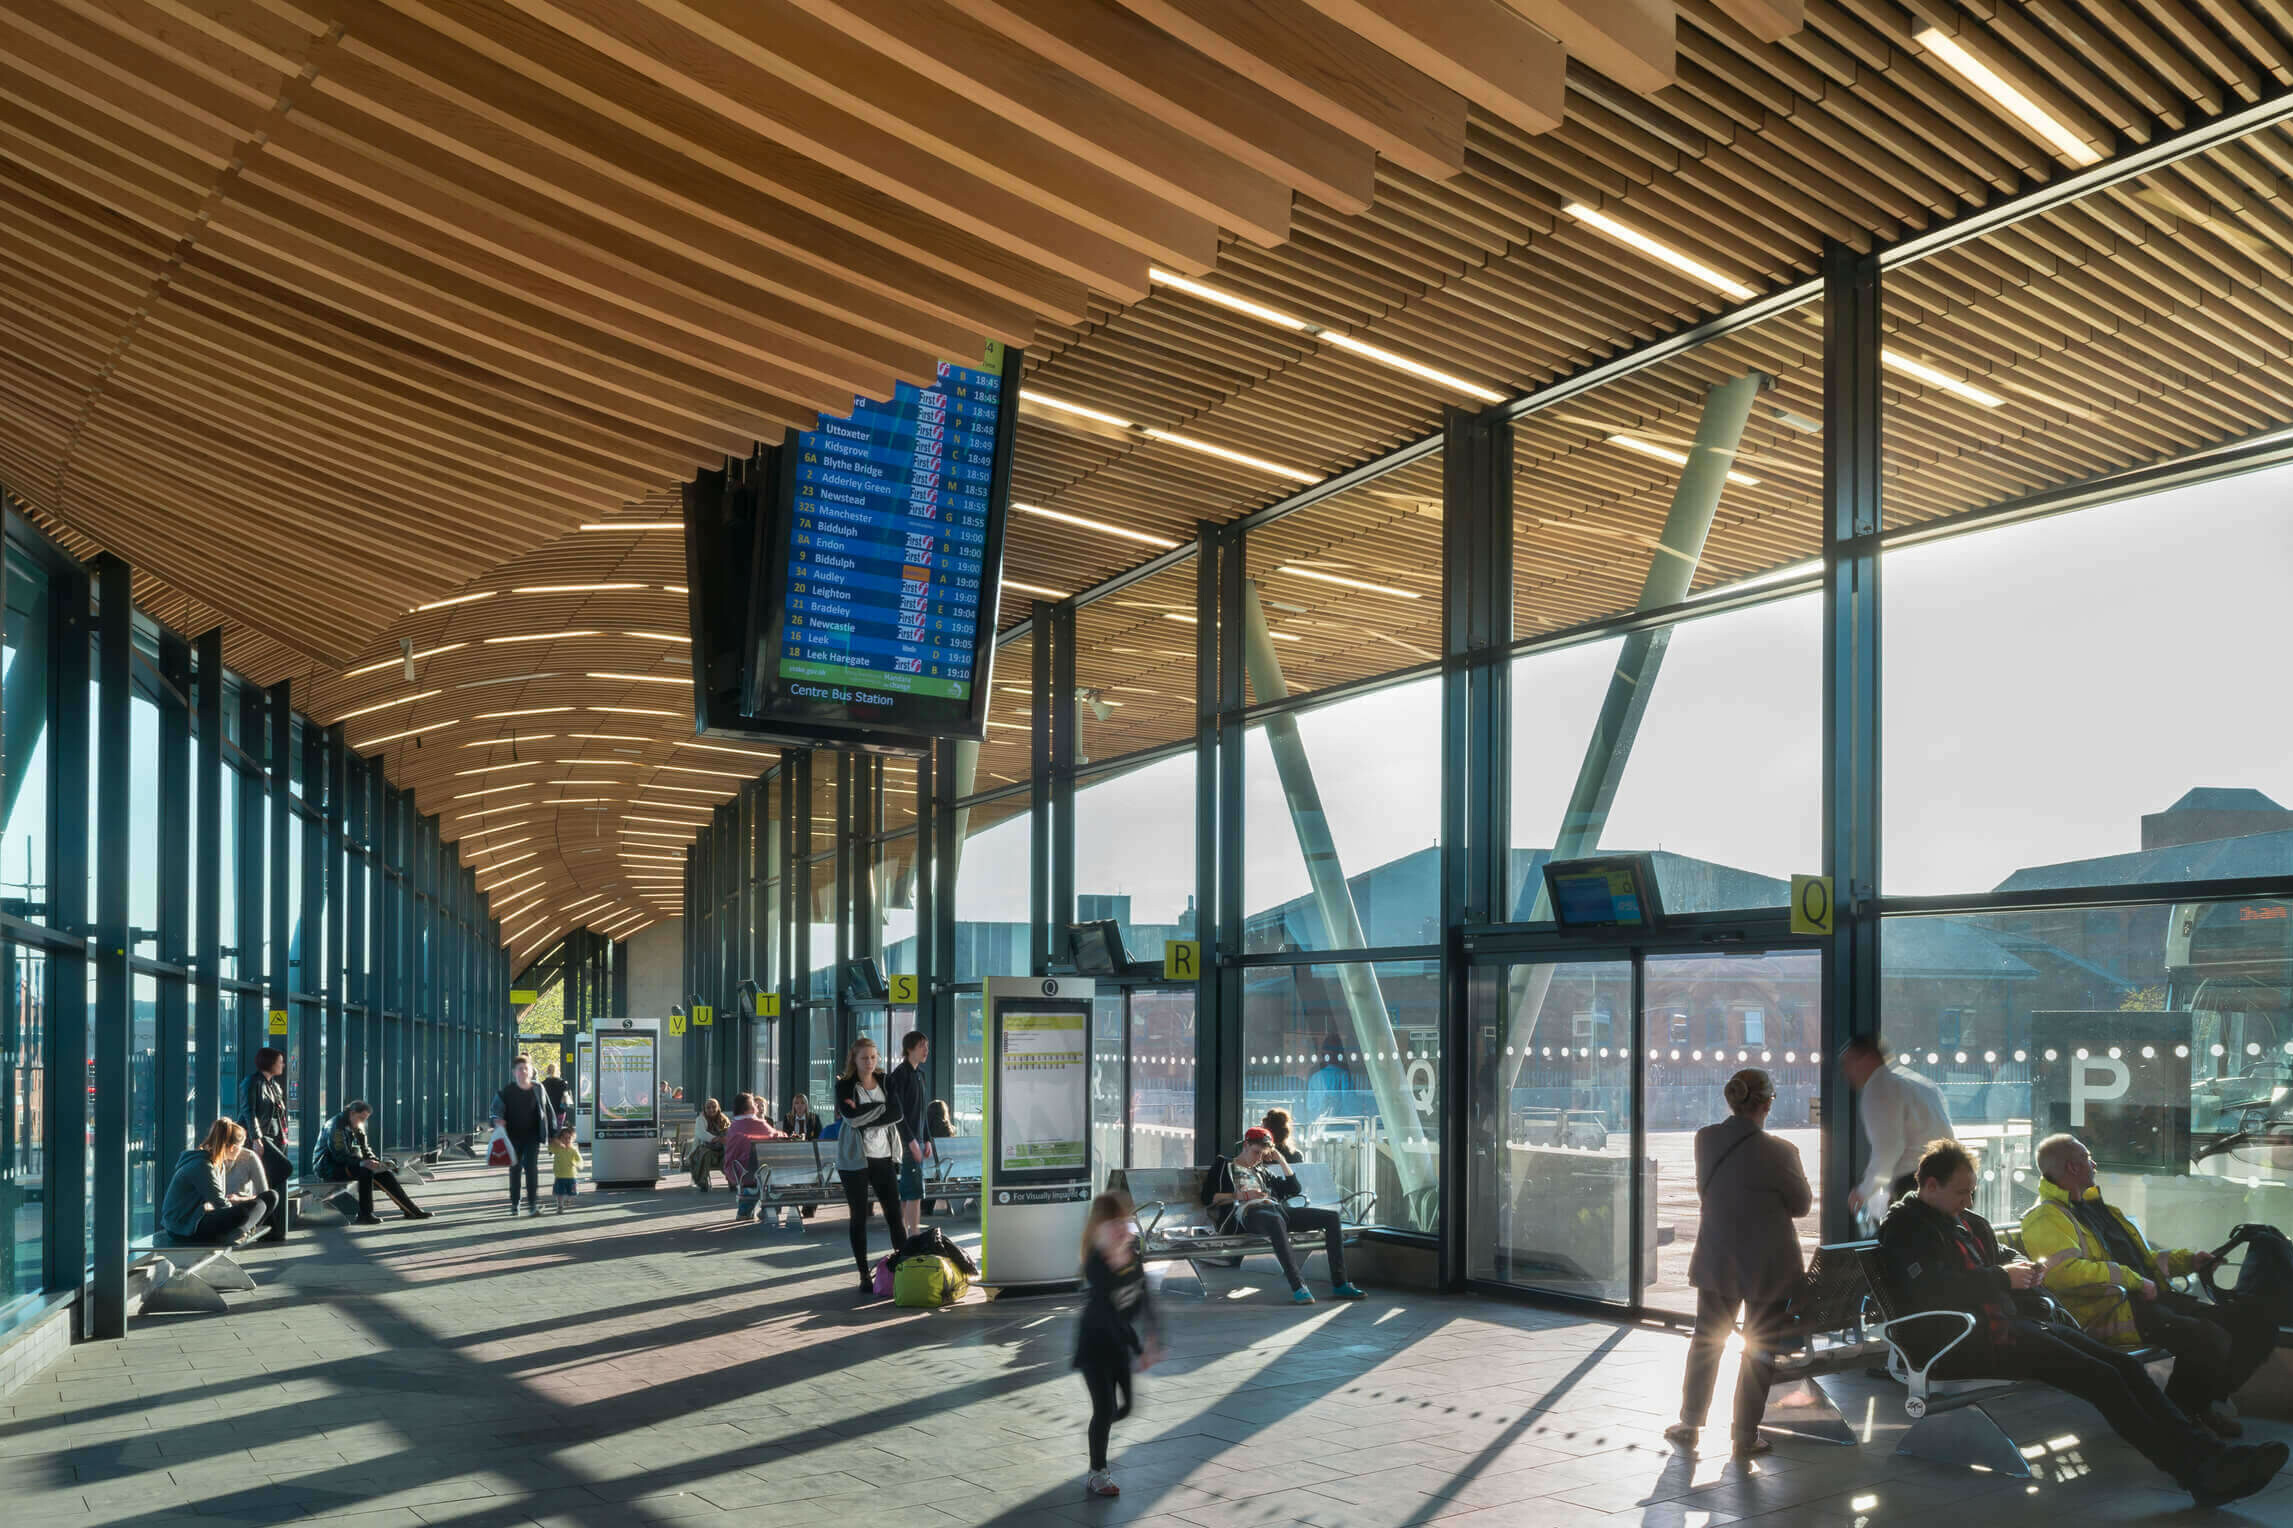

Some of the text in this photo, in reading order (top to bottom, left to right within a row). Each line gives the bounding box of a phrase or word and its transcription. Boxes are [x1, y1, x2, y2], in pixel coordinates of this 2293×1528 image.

[957, 386, 997, 404] M 18:45
[976, 376, 999, 388] 18:45
[972, 423, 994, 435] 18:48
[973, 407, 995, 420] 18:45
[810, 436, 816, 446] 7
[824, 440, 869, 457] Kidsgrove
[967, 469, 989, 481] 18:50
[826, 423, 870, 441] Uttoxeter
[952, 450, 958, 459] C
[968, 454, 991, 466] 18:49
[970, 438, 992, 450] 18:49
[804, 452, 817, 464] 6A
[824, 456, 852, 471] Blythe
[854, 462, 883, 477] Bridge
[948, 481, 957, 491] M
[965, 485, 988, 496] 18:53
[802, 486, 814, 496] 23
[820, 488, 865, 505] Newstead
[962, 516, 985, 528] 18:55
[807, 470, 813, 479] 2
[822, 473, 862, 490] Adderley
[864, 481, 891, 494] Green
[947, 497, 954, 506] A
[964, 500, 986, 512] 18:55
[799, 502, 815, 512] 325
[819, 505, 872, 523] Manchester
[961, 531, 983, 543] 19:00
[800, 518, 811, 528] 7A
[818, 521, 858, 537] Biddulph
[960, 546, 982, 558] 19:00
[798, 534, 810, 544] 8A
[816, 537, 845, 551] Endon
[958, 561, 980, 573] 19:00
[800, 551, 978, 588] 9 Biddulph A 19:00
[794, 583, 806, 592] 20
[812, 586, 851, 599] Leighton
[938, 605, 943, 614] E
[953, 608, 975, 618] 19:04
[796, 567, 807, 576] 34
[813, 570, 845, 584] Audley
[954, 592, 977, 603] 19:02
[792, 599, 803, 609] 21
[811, 602, 850, 618] Bradeley
[952, 623, 974, 634] 19:05
[792, 615, 803, 625] 26
[809, 617, 856, 633] Newcastle
[934, 636, 940, 645] C
[950, 638, 972, 649] 19:05
[789, 647, 800, 656] 18
[807, 649, 828, 660] Leek
[830, 652, 870, 666] Haregate
[947, 668, 970, 678] 19:10
[791, 631, 801, 640] 16
[808, 633, 829, 644] Leek
[949, 653, 971, 663] 19:10
[790, 684, 894, 705] Centre Bus Station
[1803, 880, 1827, 930] Q
[1175, 945, 1191, 974] R
[762, 996, 775, 1012] T
[898, 978, 911, 999] S
[1044, 980, 1056, 995] Q
[624, 1020, 632, 1028] S
[673, 1018, 682, 1030] V
[698, 1008, 708, 1022] U
[1407, 1059, 1435, 1116] Q
[2071, 1056, 2130, 1126] P
[1014, 1192, 1024, 1200] For
[1026, 1192, 1050, 1201] Visually
